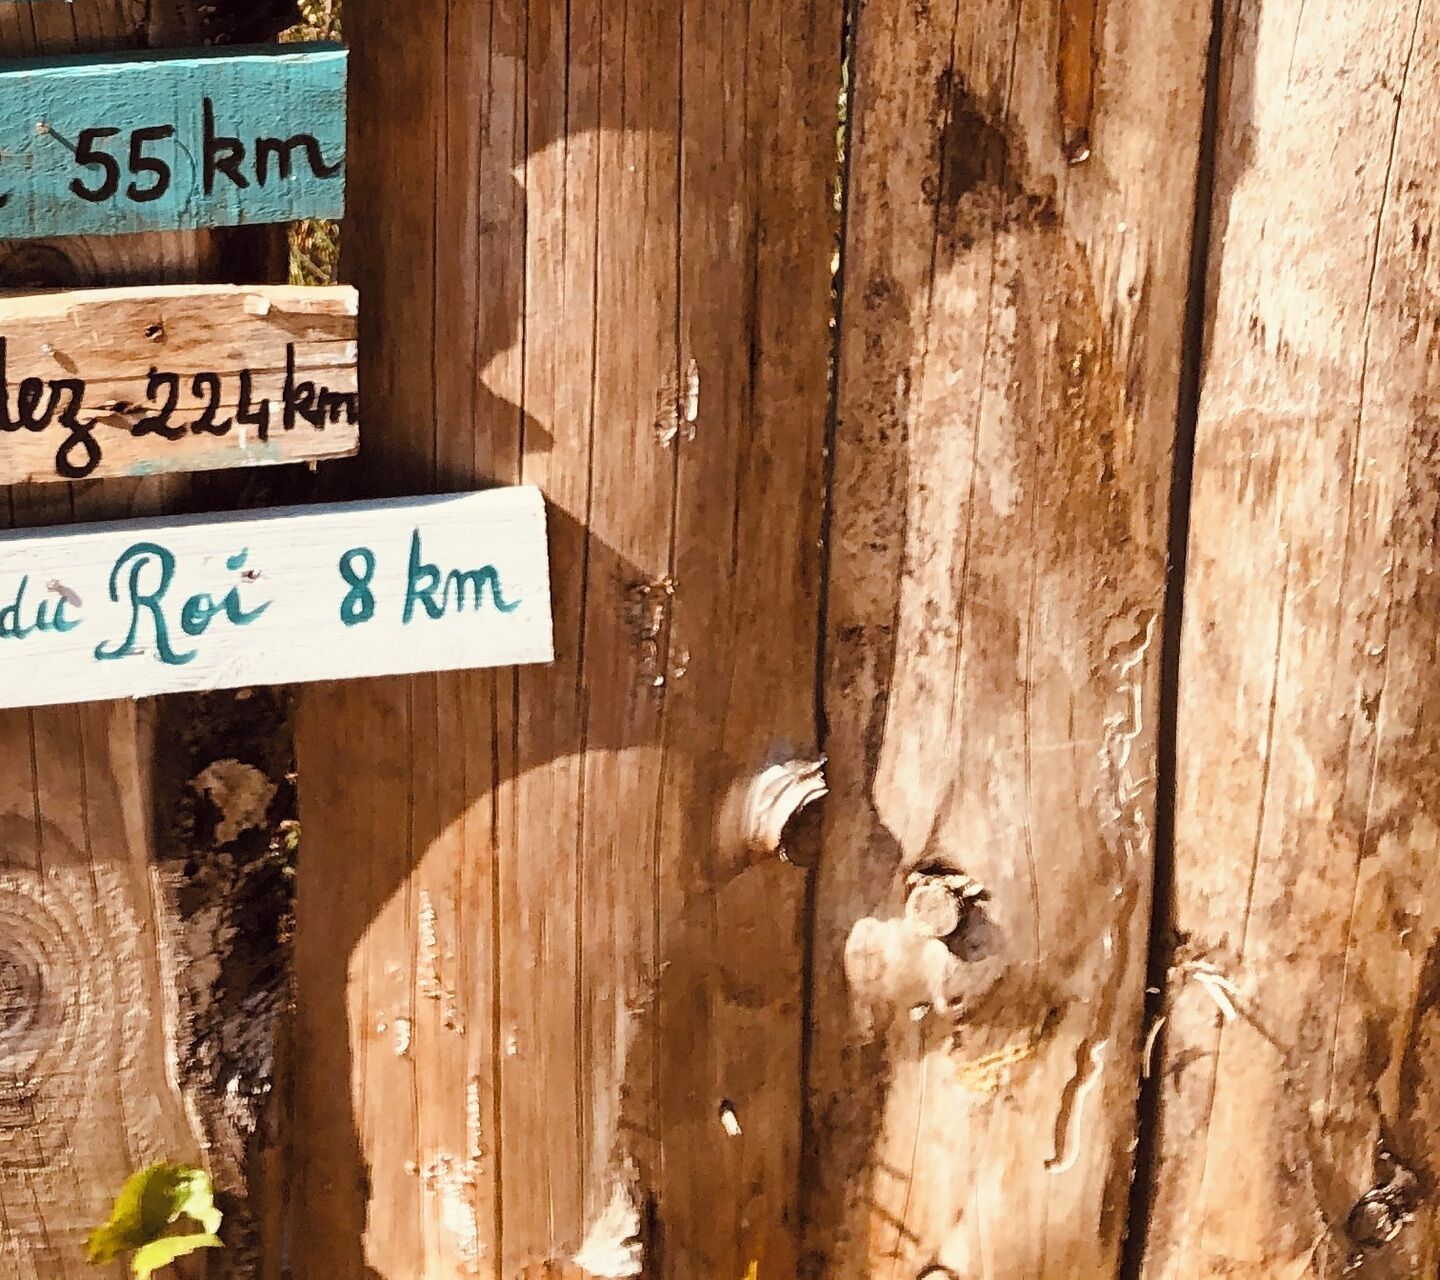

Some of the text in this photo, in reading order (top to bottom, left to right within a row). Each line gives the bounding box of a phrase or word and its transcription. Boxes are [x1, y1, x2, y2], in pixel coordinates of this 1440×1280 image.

[70, 125, 175, 202] 55
[203, 97, 341, 196] km
[132, 366, 270, 441] 224
[283, 342, 358, 430] km
[94, 541, 273, 664] Roi
[338, 546, 375, 626] 8
[402, 526, 521, 620] km
